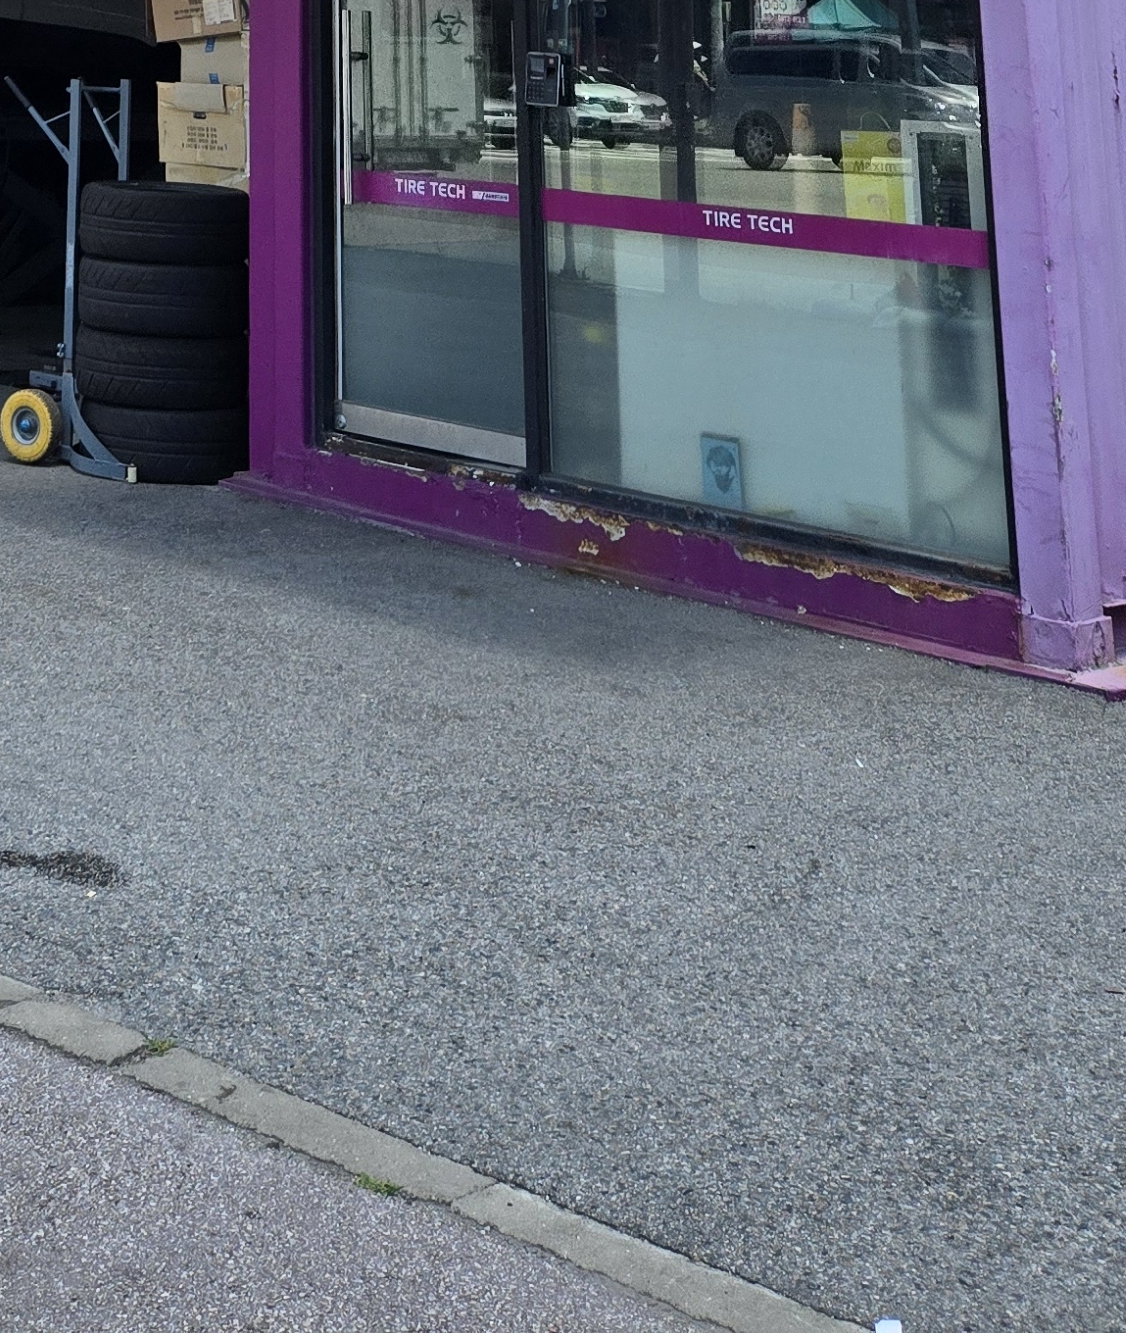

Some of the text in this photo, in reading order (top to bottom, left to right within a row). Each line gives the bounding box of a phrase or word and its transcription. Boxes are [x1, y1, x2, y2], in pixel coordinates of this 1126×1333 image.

[394, 177, 426, 197] TIRE
[429, 180, 467, 201] TECH
[702, 209, 795, 235] TIRE TECH
